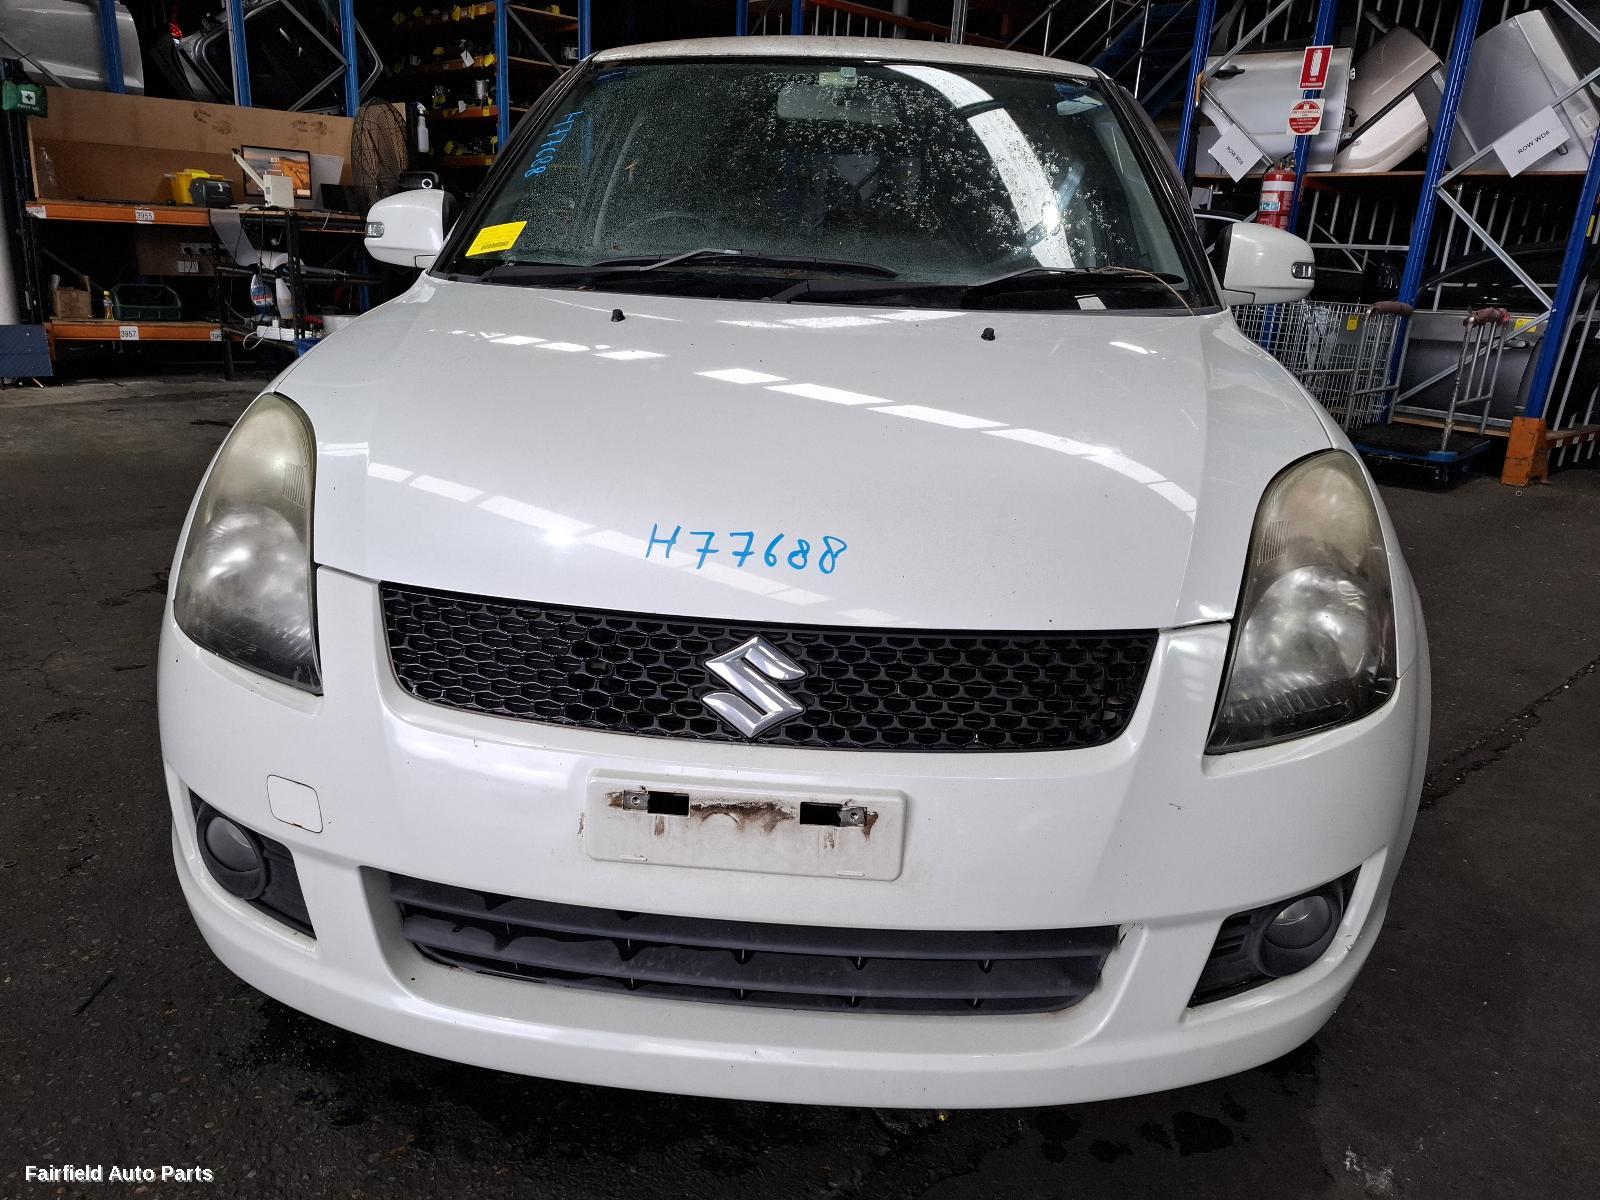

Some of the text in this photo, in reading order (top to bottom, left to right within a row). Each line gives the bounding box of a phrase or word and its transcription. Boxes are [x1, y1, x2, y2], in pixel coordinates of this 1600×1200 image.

[1517, 139, 1534, 155] ROW
[136, 211, 153, 220] 3955
[120, 330, 137, 338] 3957
[645, 523, 848, 575] H77688
